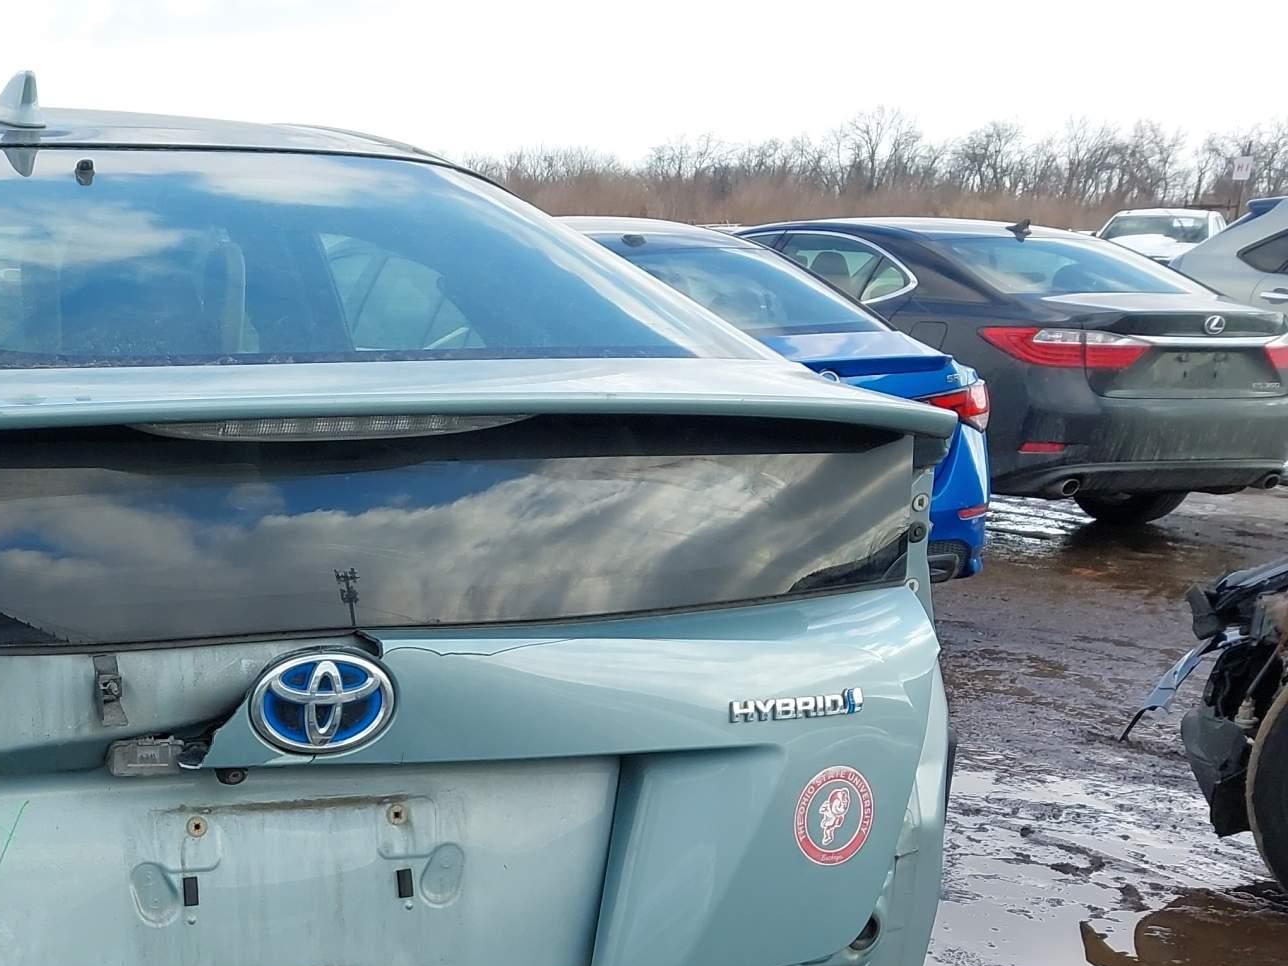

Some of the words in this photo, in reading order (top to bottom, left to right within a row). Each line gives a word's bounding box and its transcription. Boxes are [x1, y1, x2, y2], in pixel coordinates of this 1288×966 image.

[729, 694, 844, 723] HYBRID
[816, 770, 846, 786] STATE
[798, 785, 816, 815] OHIO
[848, 771, 872, 835] UNIVERSITY
[796, 815, 806, 843] THE
